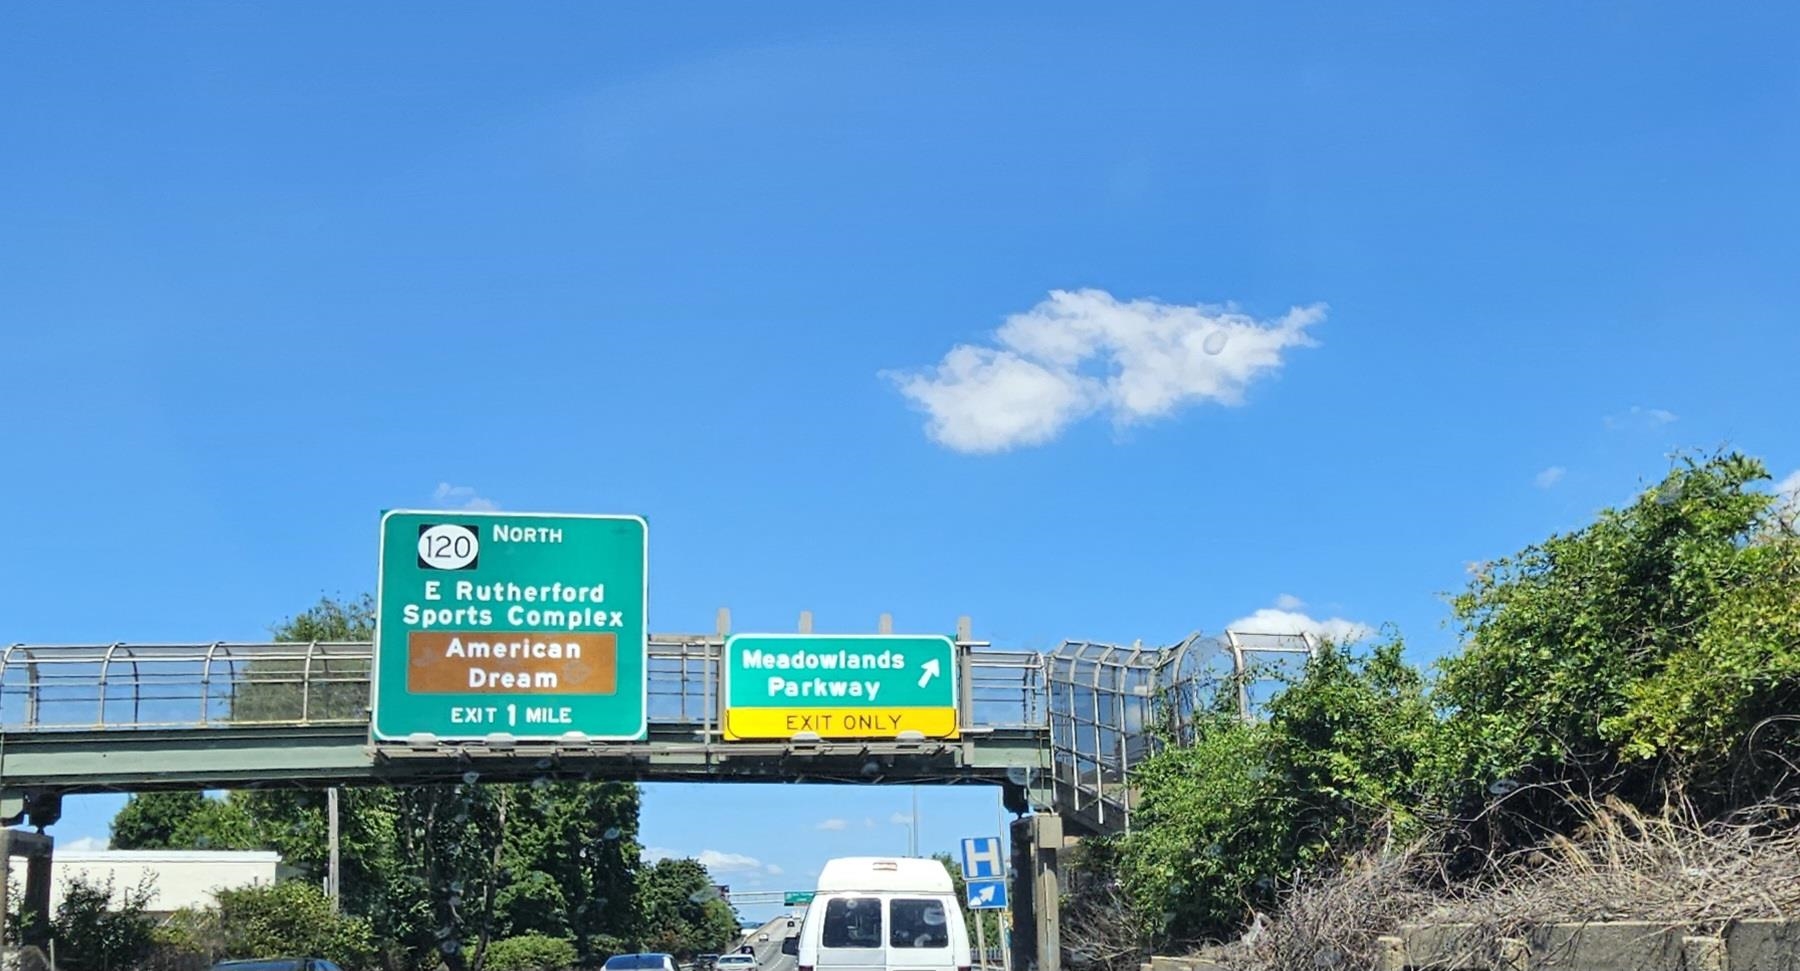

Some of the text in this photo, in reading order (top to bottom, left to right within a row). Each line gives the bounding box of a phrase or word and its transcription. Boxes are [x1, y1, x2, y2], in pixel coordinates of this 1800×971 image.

[426, 535, 471, 558] 120
[425, 581, 605, 603] E Rutherford
[403, 605, 623, 630] Sports Complex
[446, 637, 581, 659] American
[742, 649, 905, 670] Meadowlands
[469, 668, 558, 689] Dream
[768, 677, 880, 701] Parkway
[451, 703, 572, 726] EXIT 1 MILE
[786, 714, 902, 730] EXIT ONLY
